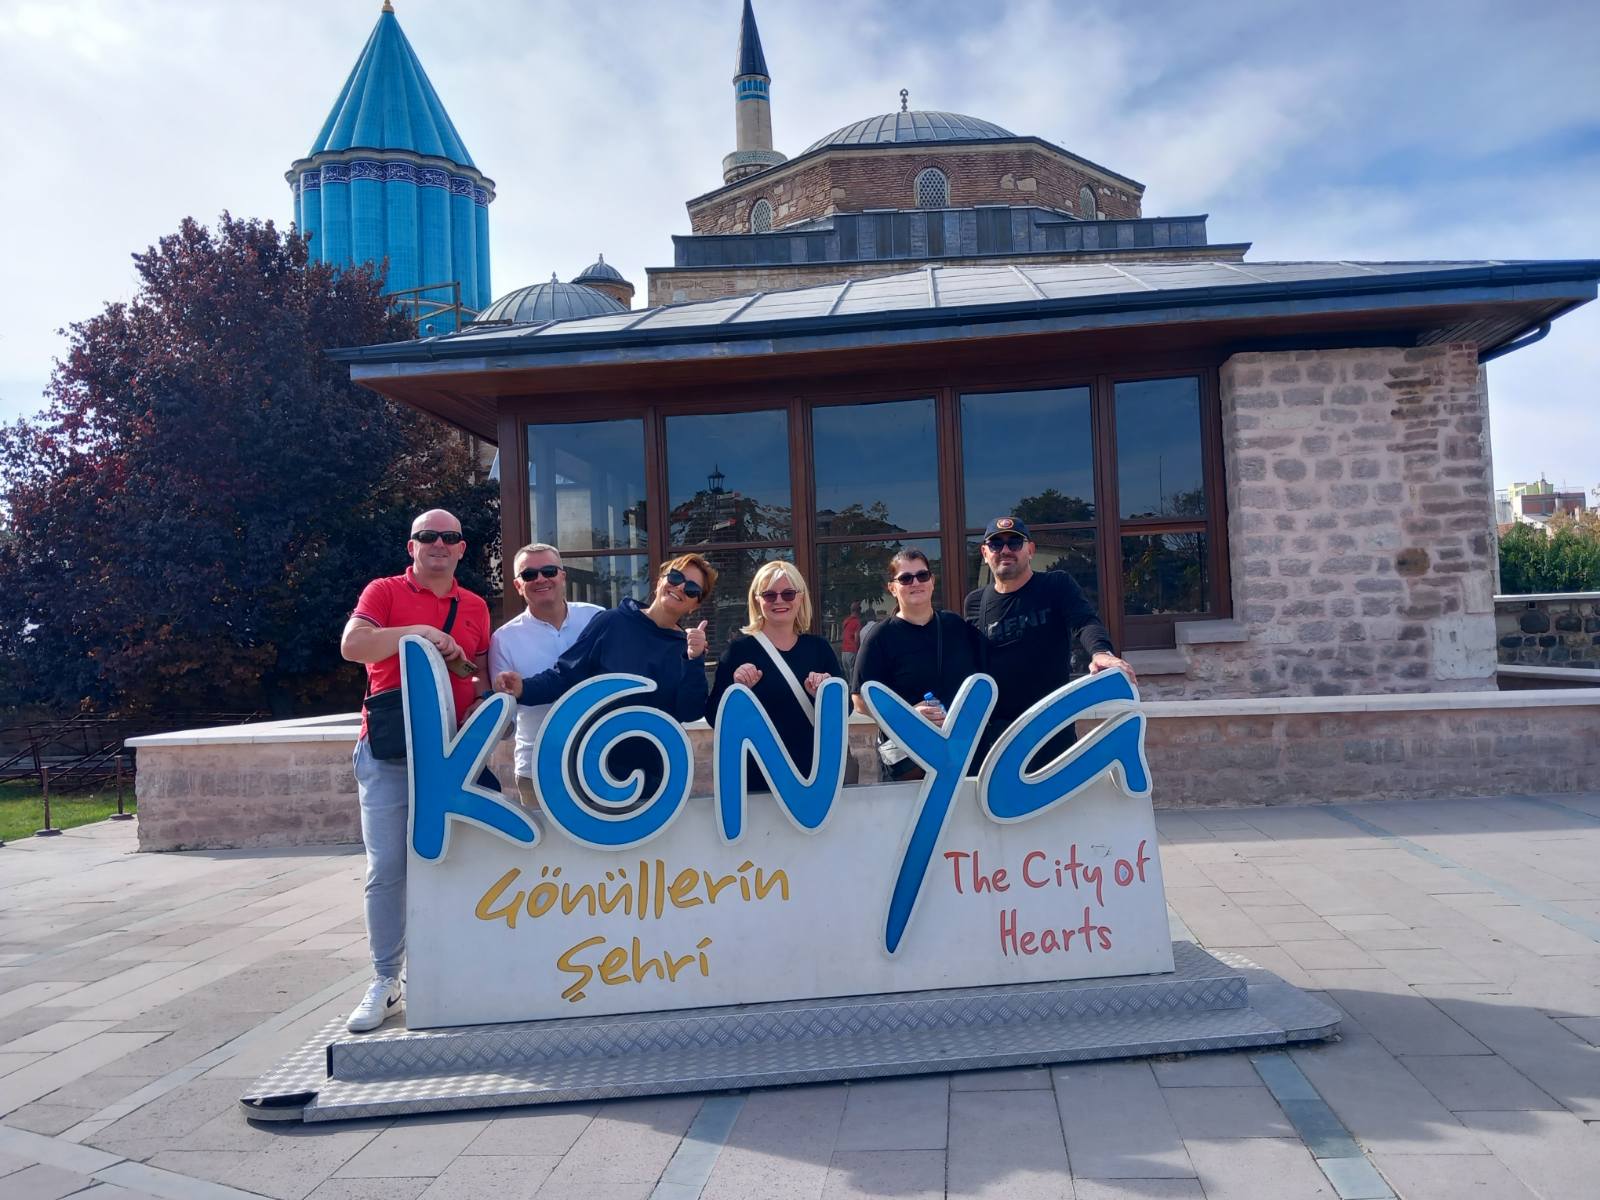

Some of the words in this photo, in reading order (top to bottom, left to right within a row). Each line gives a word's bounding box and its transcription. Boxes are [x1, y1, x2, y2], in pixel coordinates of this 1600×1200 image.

[943, 850, 1011, 895] The
[1022, 843, 1105, 908] City
[1113, 839, 1152, 888] of
[999, 906, 1113, 957] Hearts
